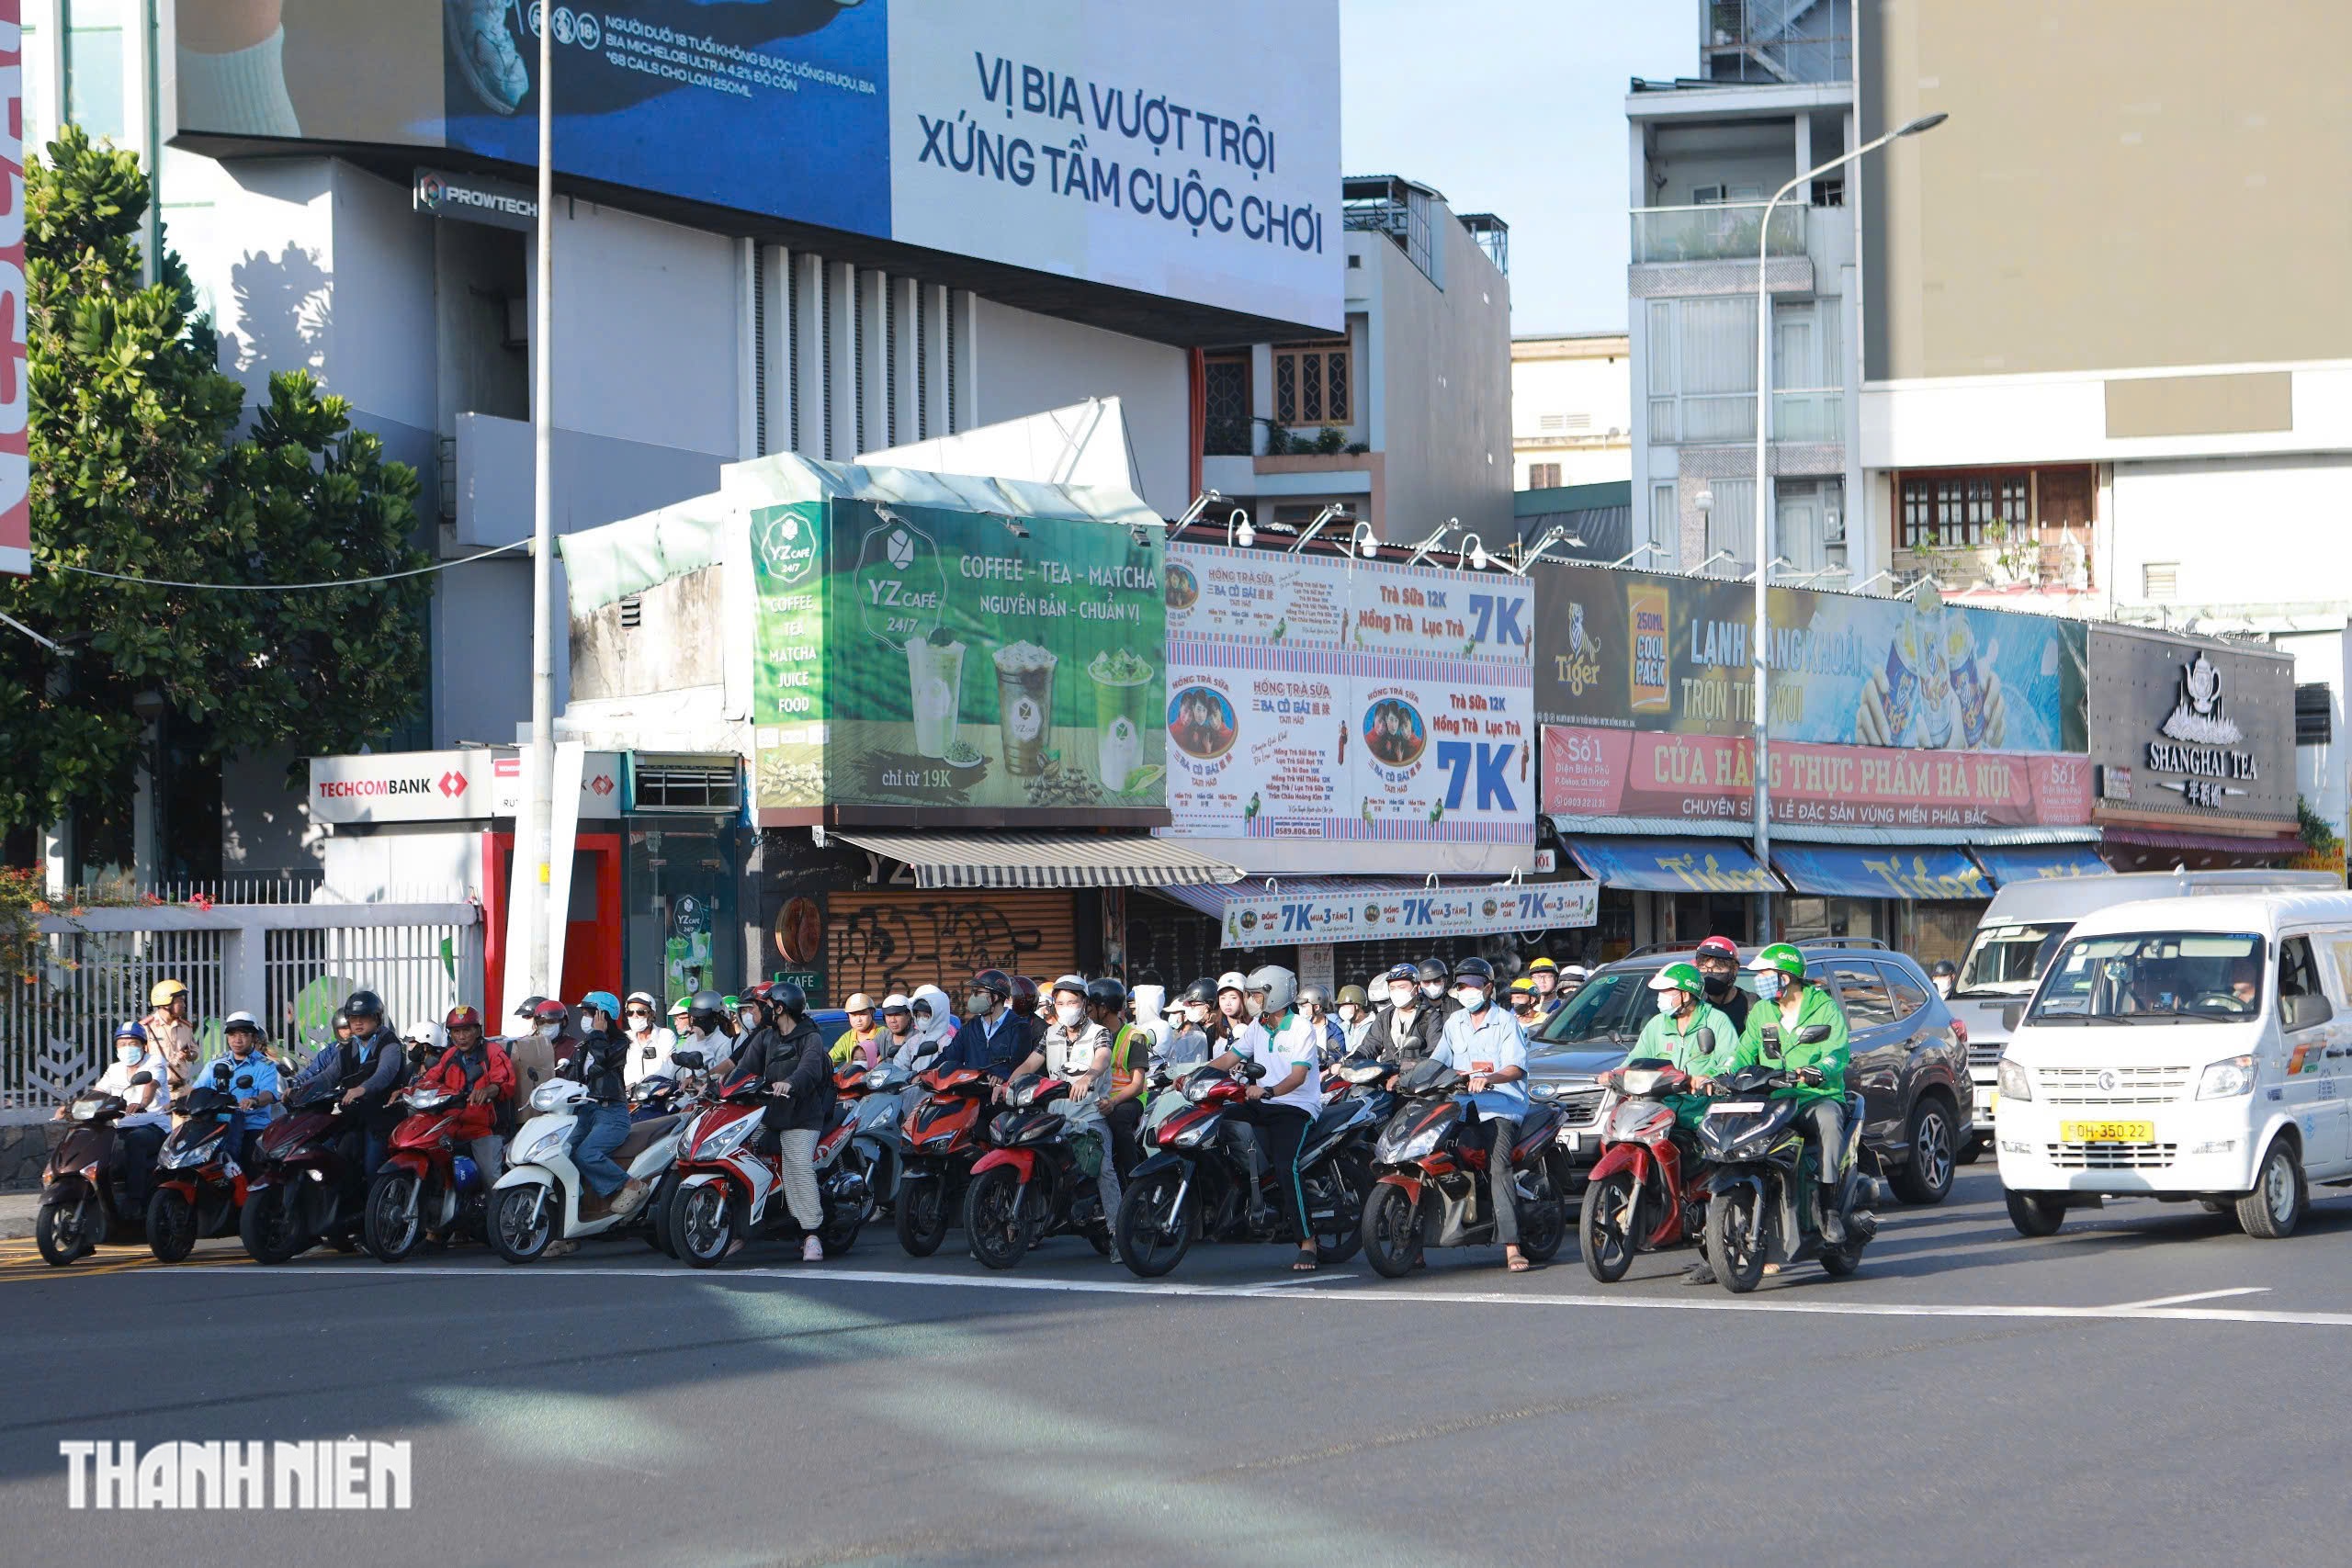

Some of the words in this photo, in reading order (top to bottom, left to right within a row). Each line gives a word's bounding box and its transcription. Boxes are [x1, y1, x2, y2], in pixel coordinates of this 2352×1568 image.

[605, 33, 626, 49] BIA
[627, 39, 688, 64] MICHELOB
[688, 54, 727, 74] ULTRA
[753, 70, 771, 87] ĐỘ
[772, 73, 797, 92] CỒN
[627, 55, 660, 74] CALS
[661, 64, 687, 82] CHO
[687, 71, 713, 88] LON
[713, 77, 752, 97] 250ML
[975, 51, 1013, 119] VỊ
[1022, 64, 1084, 125] BIA
[1088, 81, 1192, 156] VƯỢT
[1196, 111, 1275, 181] TRỘI
[918, 109, 1035, 186] XỨNG
[1042, 134, 1120, 208] TẦM
[1128, 168, 1234, 237] CUỘC
[1240, 195, 1322, 254] CHƠI
[446, 186, 537, 218] PROWTECH
[770, 546, 791, 560] YZ
[781, 563, 800, 573] 24/7
[960, 555, 1023, 581] COFFEE
[1040, 561, 1072, 585] TEA
[1089, 565, 1157, 589] MATCHA
[1208, 567, 1236, 582] HỒNG
[1237, 570, 1256, 584] TRÀ
[1256, 571, 1275, 586] SỮA
[770, 594, 815, 613] COFFEE
[867, 579, 901, 607] YZ
[902, 591, 936, 609] CAFÉ
[1380, 585, 1399, 604] Trà
[1402, 587, 1424, 607] Sữa
[1427, 591, 1447, 609] 12K
[979, 592, 1035, 616] NGUYÊN
[1041, 593, 1067, 617] BẢN
[1079, 592, 1125, 621] CHUẨN
[1127, 604, 1140, 626] VỊ
[785, 621, 805, 637] TEA
[886, 617, 918, 633] 24/7
[1359, 608, 1391, 634] Hồng
[1394, 613, 1413, 632] Trà
[1421, 616, 1442, 639] Lục
[1445, 619, 1464, 637] Trà
[1469, 594, 1525, 645] 7K
[1636, 612, 1664, 632] 250ML
[769, 646, 817, 662] MATCHA
[1636, 635, 1666, 660] COOL
[1690, 618, 1746, 671] LẠNH
[1804, 625, 1862, 677] KHOÁI
[778, 671, 809, 688] JUICE
[1172, 674, 1194, 690] HỒNG
[1196, 674, 1212, 683] TRÀ
[1214, 676, 1229, 692] SỮA
[1555, 653, 1600, 696] Tiger
[1634, 660, 1665, 686] PACK
[1253, 678, 1284, 695] HỒNG
[1286, 681, 1308, 696] TRÀ
[1309, 682, 1330, 697] SỮA
[778, 697, 809, 714] FOOD
[1261, 699, 1275, 713] BA
[1277, 698, 1291, 714] CÔ
[1293, 699, 1310, 715] GÁI
[1450, 694, 1466, 709] Trà
[1468, 694, 1487, 711] Sữa
[1489, 696, 1506, 712] 12K
[1681, 678, 1727, 732] TRỌN
[1775, 685, 1803, 727] VUI
[1433, 714, 1460, 735] Hồng
[1462, 716, 1478, 733] Trà
[1485, 719, 1502, 738] Lục
[1505, 720, 1521, 735] Trà
[1567, 734, 1591, 762] Số
[1594, 739, 1602, 762] 1
[1655, 736, 1708, 784] CỬA
[1714, 741, 1781, 788] HÀG
[1790, 754, 1853, 799] THỰC
[1860, 750, 1929, 796] PHẨM
[1938, 755, 1970, 797] HÀ
[1976, 757, 2010, 805] NỘI
[2150, 742, 2226, 777] SHANGHAI
[2231, 750, 2257, 780] TEA
[882, 770, 902, 786] chỉ
[904, 771, 921, 786] từ
[922, 770, 952, 786] 19K
[1437, 740, 1518, 811] 7K
[2052, 761, 2068, 784] Số
[319, 778, 431, 798] TECHCOMBANK
[1682, 796, 1736, 816] CHUYÊN
[1739, 796, 1752, 817] SỈ
[1779, 799, 1794, 818] LẺ
[1798, 802, 1826, 823] ĐẶC
[1829, 802, 1855, 821] SẢN
[1860, 805, 1894, 823] VÙNG
[1898, 804, 1928, 824] MIỀN
[1931, 806, 1960, 824] PHÍA
[1964, 804, 1988, 825] BẮC
[1275, 828, 1320, 836] 0589.806.806
[1383, 906, 1399, 915] ĐỒNG
[1402, 898, 1434, 926] 7K
[1443, 903, 1452, 917] 3
[1452, 906, 1467, 916] TẶNG
[1467, 901, 1472, 917] 1
[1500, 900, 1516, 908] ĐỒNG
[1502, 909, 1512, 918] GIÁ
[1519, 893, 1547, 919] 7K
[1555, 897, 1564, 911] 3
[1564, 899, 1578, 908] TẶNG
[1578, 895, 1584, 910] 1
[677, 915, 689, 924] YZ
[1261, 911, 1278, 920] ĐỒNG
[1281, 904, 1314, 932] 7K
[1323, 908, 1331, 924] 3
[1332, 911, 1348, 921] TẶNG
[1349, 907, 1354, 923] 1
[1385, 916, 1396, 924] GIÁ
[1264, 921, 1274, 931] GIÁ
[1778, 952, 1799, 963] Grab
[787, 976, 814, 987] CAFE
[1684, 979, 1702, 990] Grab
